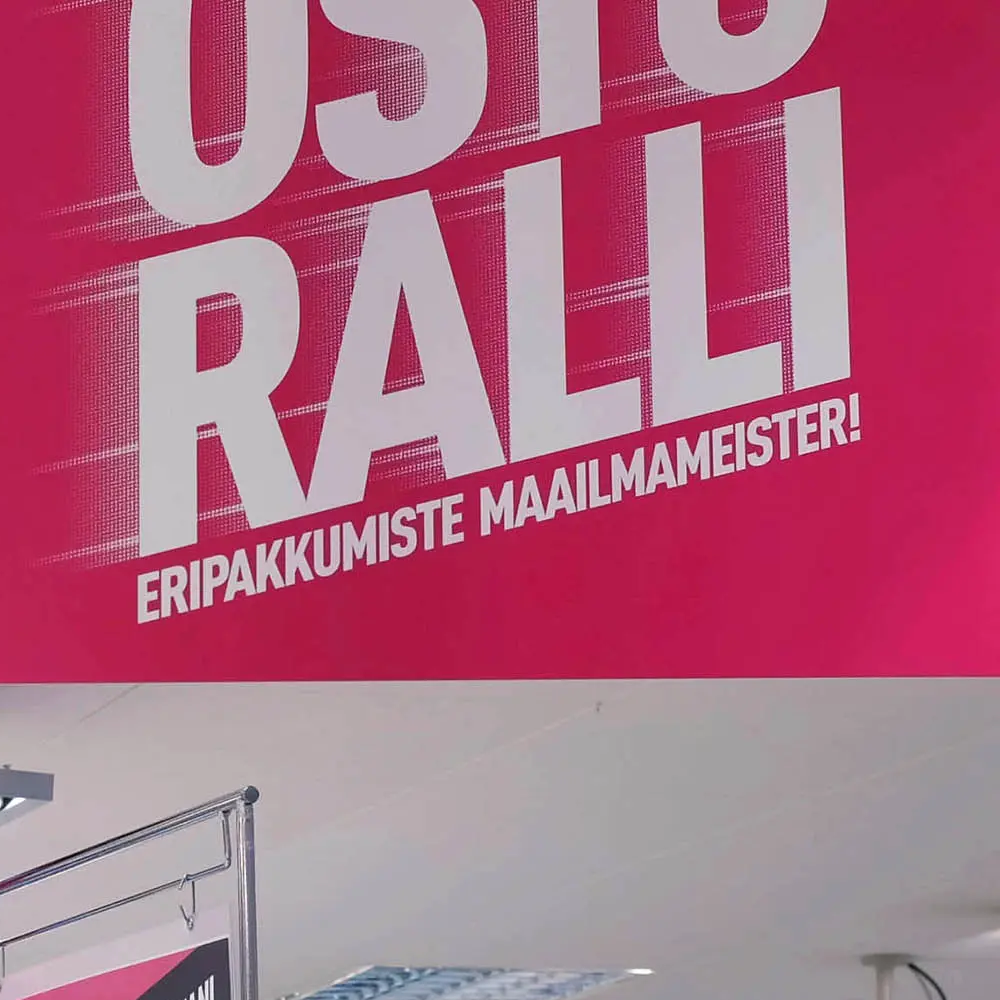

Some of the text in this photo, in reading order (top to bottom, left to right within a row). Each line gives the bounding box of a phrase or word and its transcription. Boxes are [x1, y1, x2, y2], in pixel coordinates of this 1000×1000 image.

[138, 87, 851, 557] RALLI
[137, 393, 861, 624] ERIPAKKUMISTE MAAILMAMEISTER!
